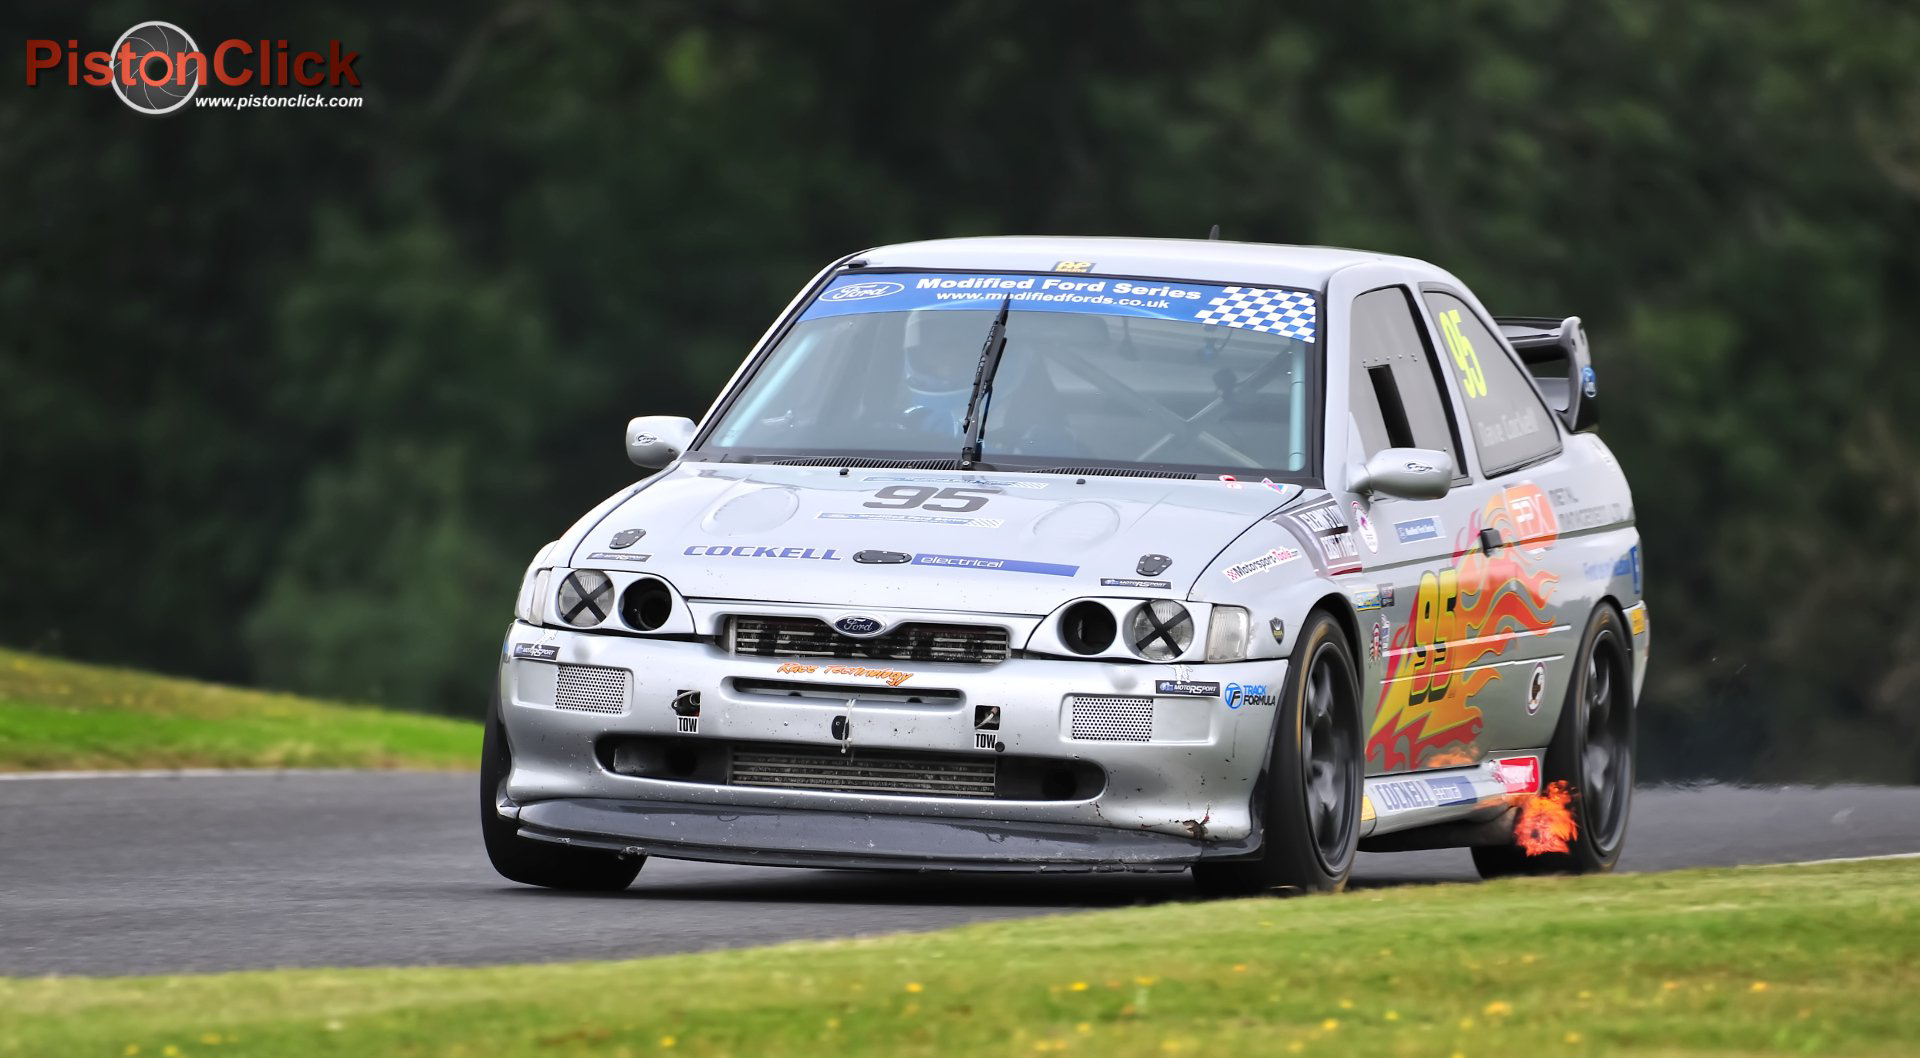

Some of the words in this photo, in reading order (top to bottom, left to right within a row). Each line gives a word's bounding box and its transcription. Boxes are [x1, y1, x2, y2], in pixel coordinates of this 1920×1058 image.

[832, 283, 890, 300] Ford
[916, 277, 1035, 290] Modified
[1041, 279, 1106, 292] Ford
[1112, 282, 1202, 300] Series
[1440, 309, 1487, 398] 95
[862, 485, 1001, 513] 95
[683, 545, 843, 561] COCKELL
[920, 555, 1004, 569] electrical
[843, 616, 873, 632] Ford
[1409, 567, 1458, 705] 95
[777, 662, 819, 674] Race
[824, 664, 914, 687] Technology
[1173, 684, 1217, 694] MOTORSPORT
[1243, 685, 1267, 695] TRACK
[1243, 695, 1276, 706] FORMULA
[679, 717, 698, 732] TOW
[975, 733, 996, 749] TOW
[1375, 780, 1436, 811] COCKELL
